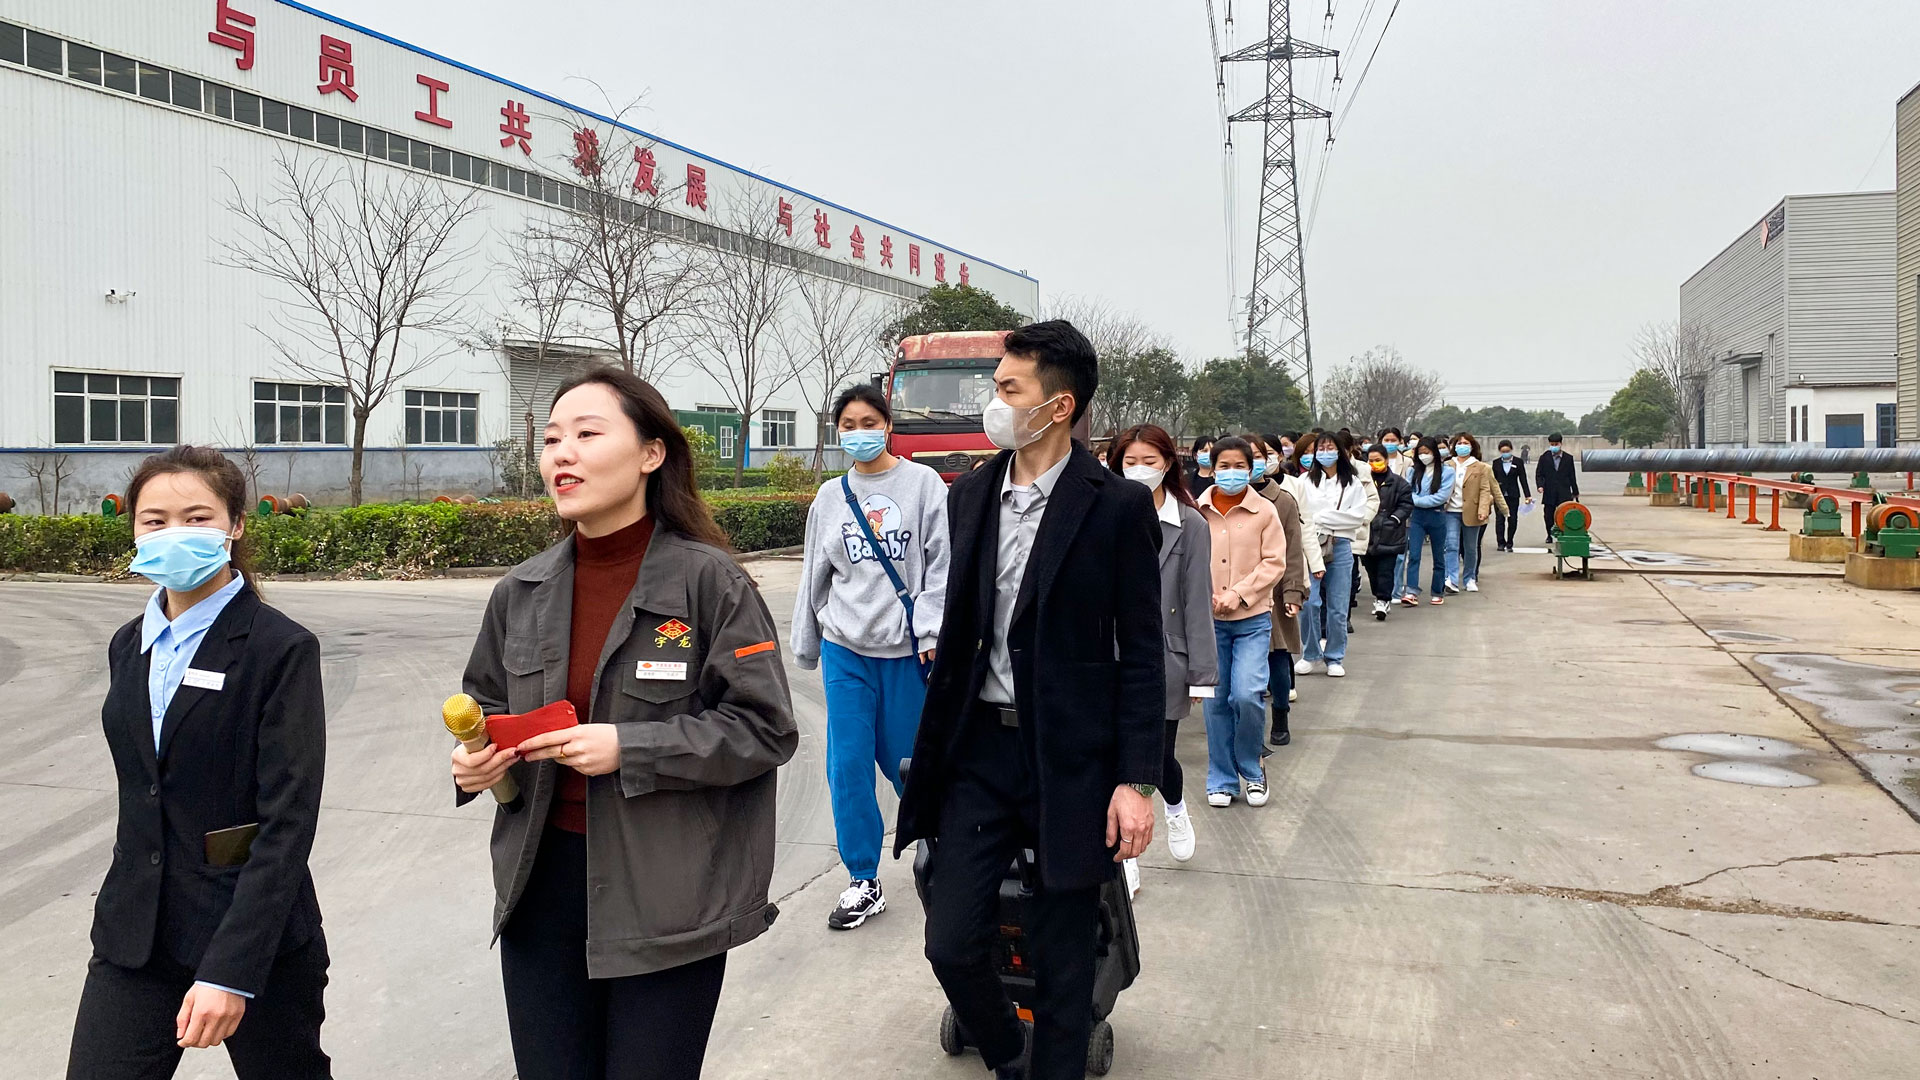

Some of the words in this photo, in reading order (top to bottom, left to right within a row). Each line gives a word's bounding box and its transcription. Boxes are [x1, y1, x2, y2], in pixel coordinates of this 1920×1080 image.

[208, 0, 707, 211] 与员工共求发展
